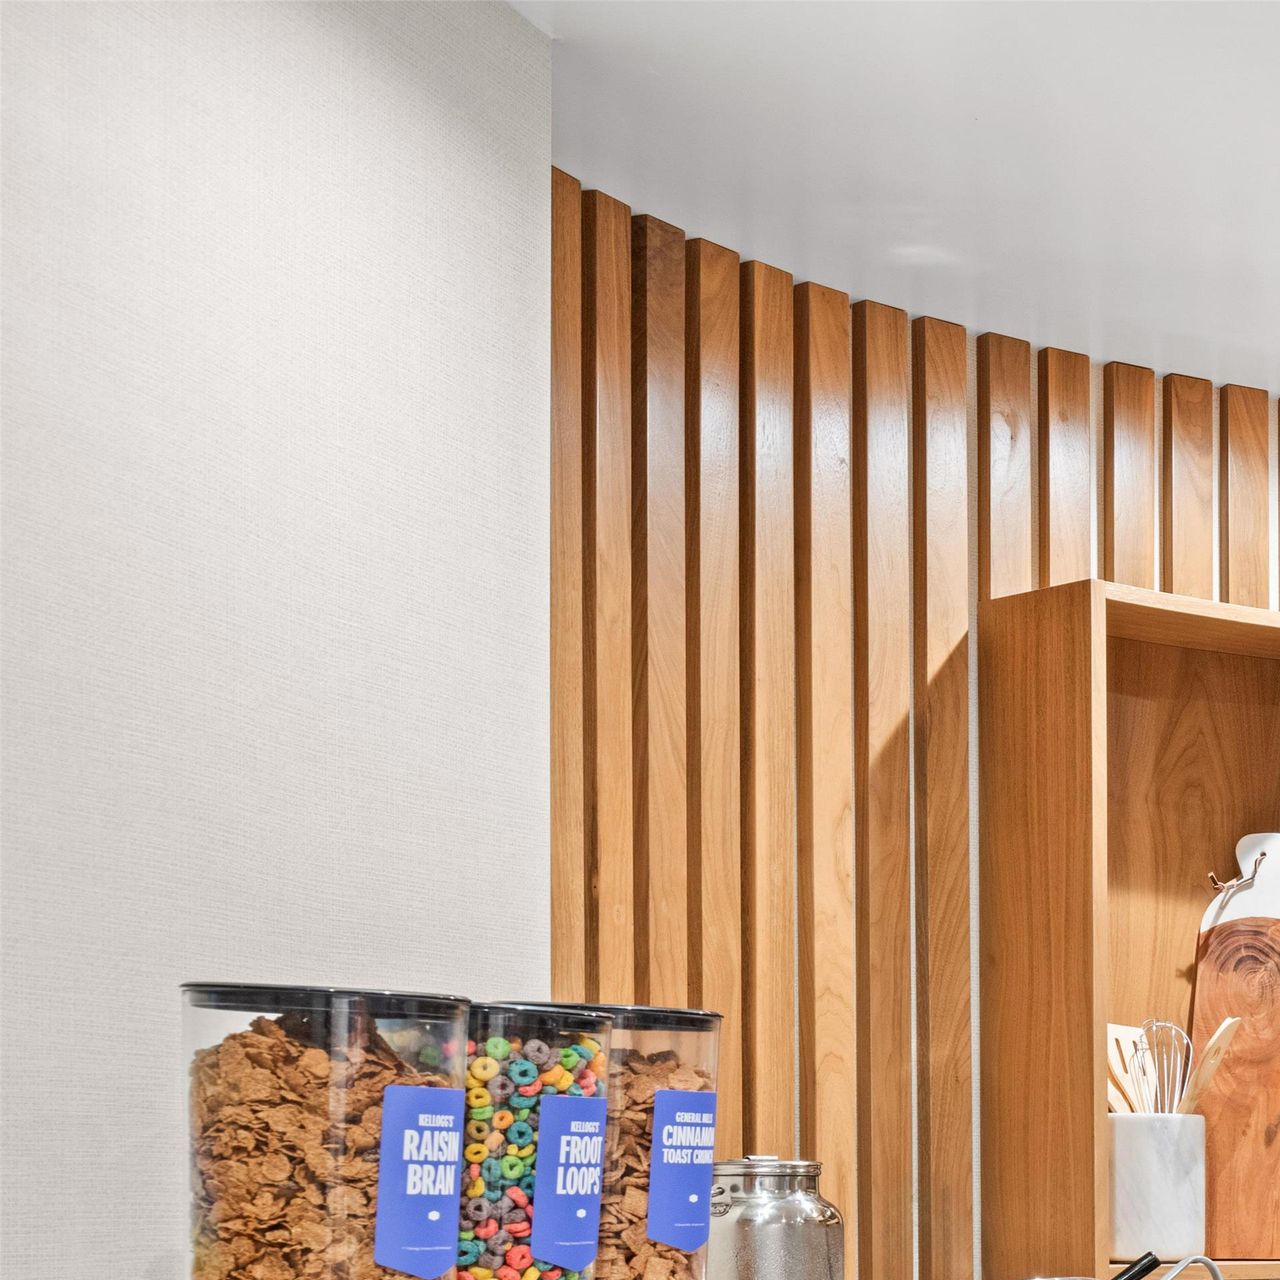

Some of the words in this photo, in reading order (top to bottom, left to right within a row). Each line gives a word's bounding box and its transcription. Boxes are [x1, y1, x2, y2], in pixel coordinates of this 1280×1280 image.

[403, 1129, 460, 1162] RAISIN
[559, 1135, 603, 1164] FROOT
[662, 1148, 693, 1164] TOAST
[406, 1164, 456, 1196] BRAN
[556, 1166, 600, 1195] LOOPS
